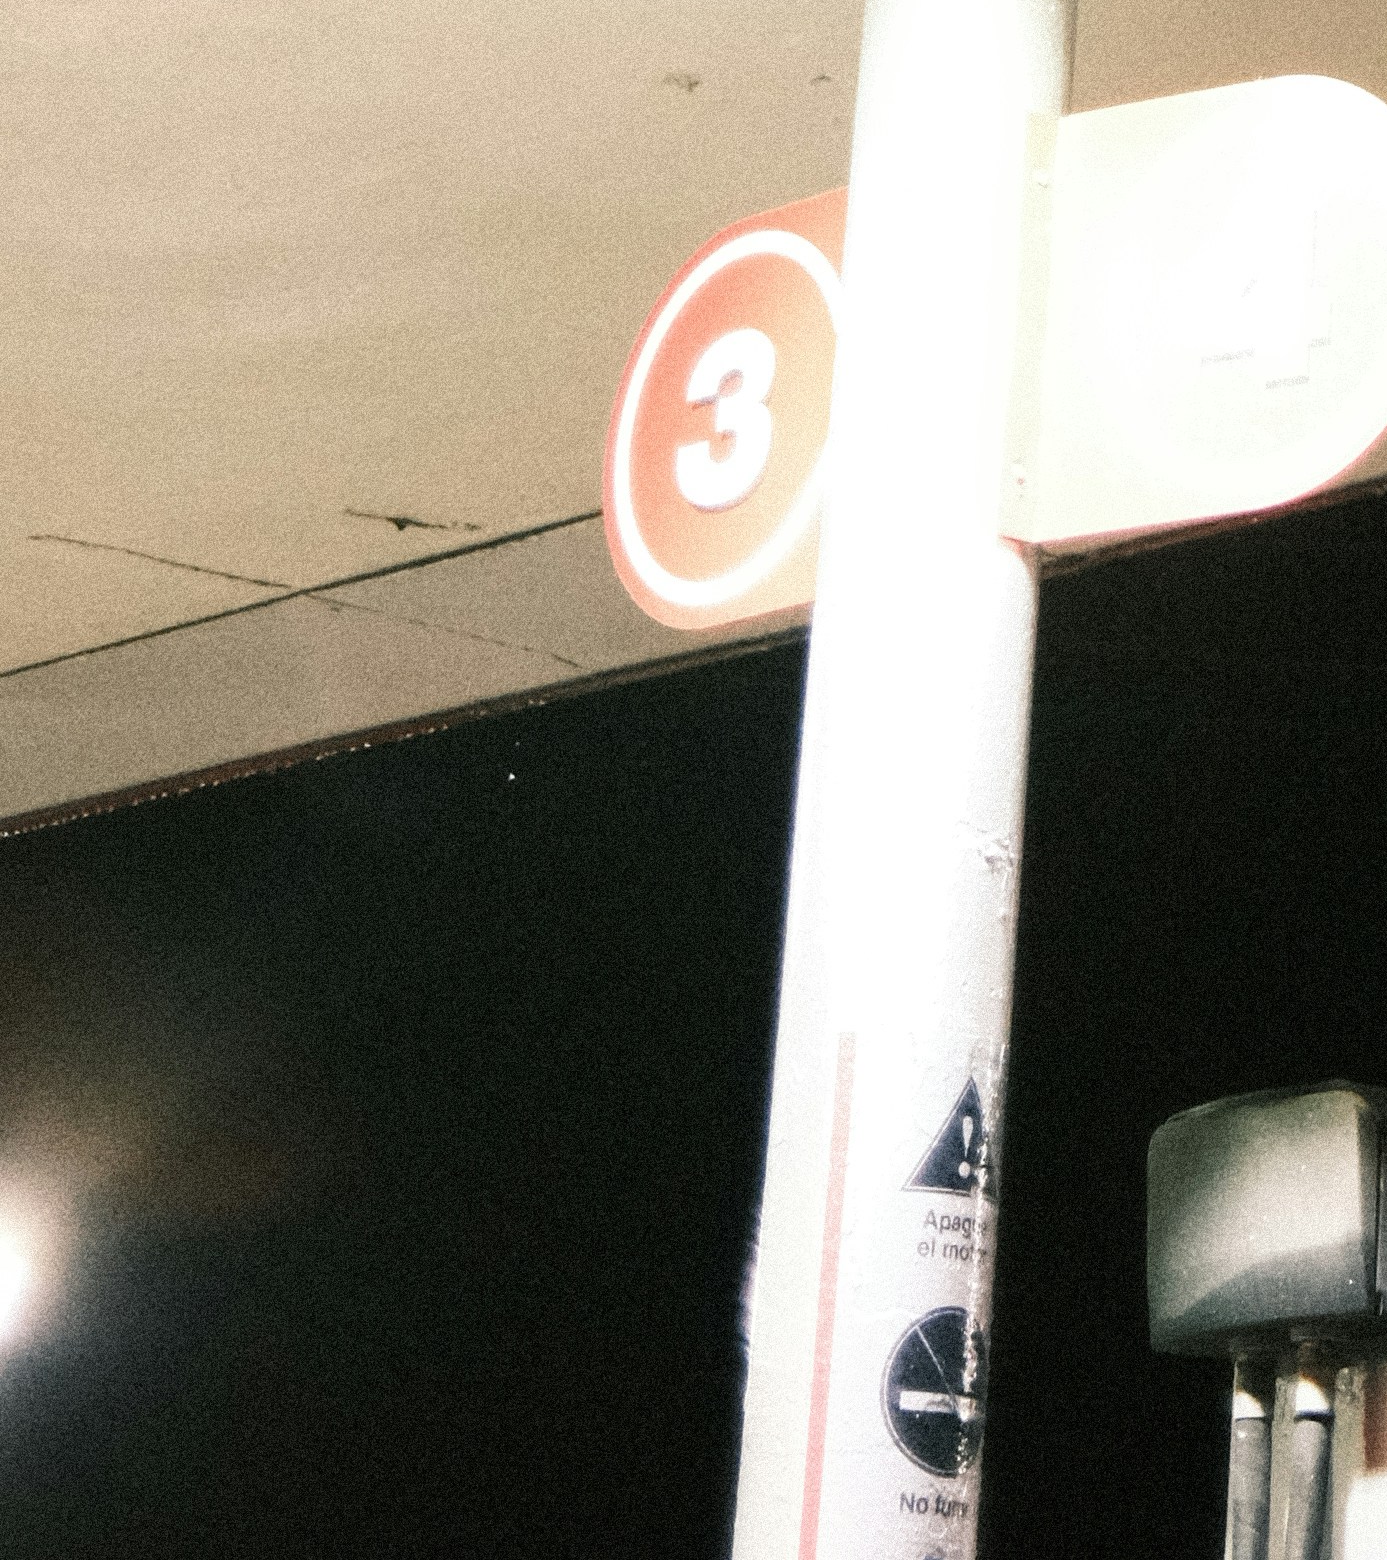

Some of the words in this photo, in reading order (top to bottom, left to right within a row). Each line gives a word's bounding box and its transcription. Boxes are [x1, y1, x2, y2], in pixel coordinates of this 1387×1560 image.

[675, 328, 776, 510] 3
[917, 1236, 935, 1257] el
[900, 1492, 929, 1514] No
